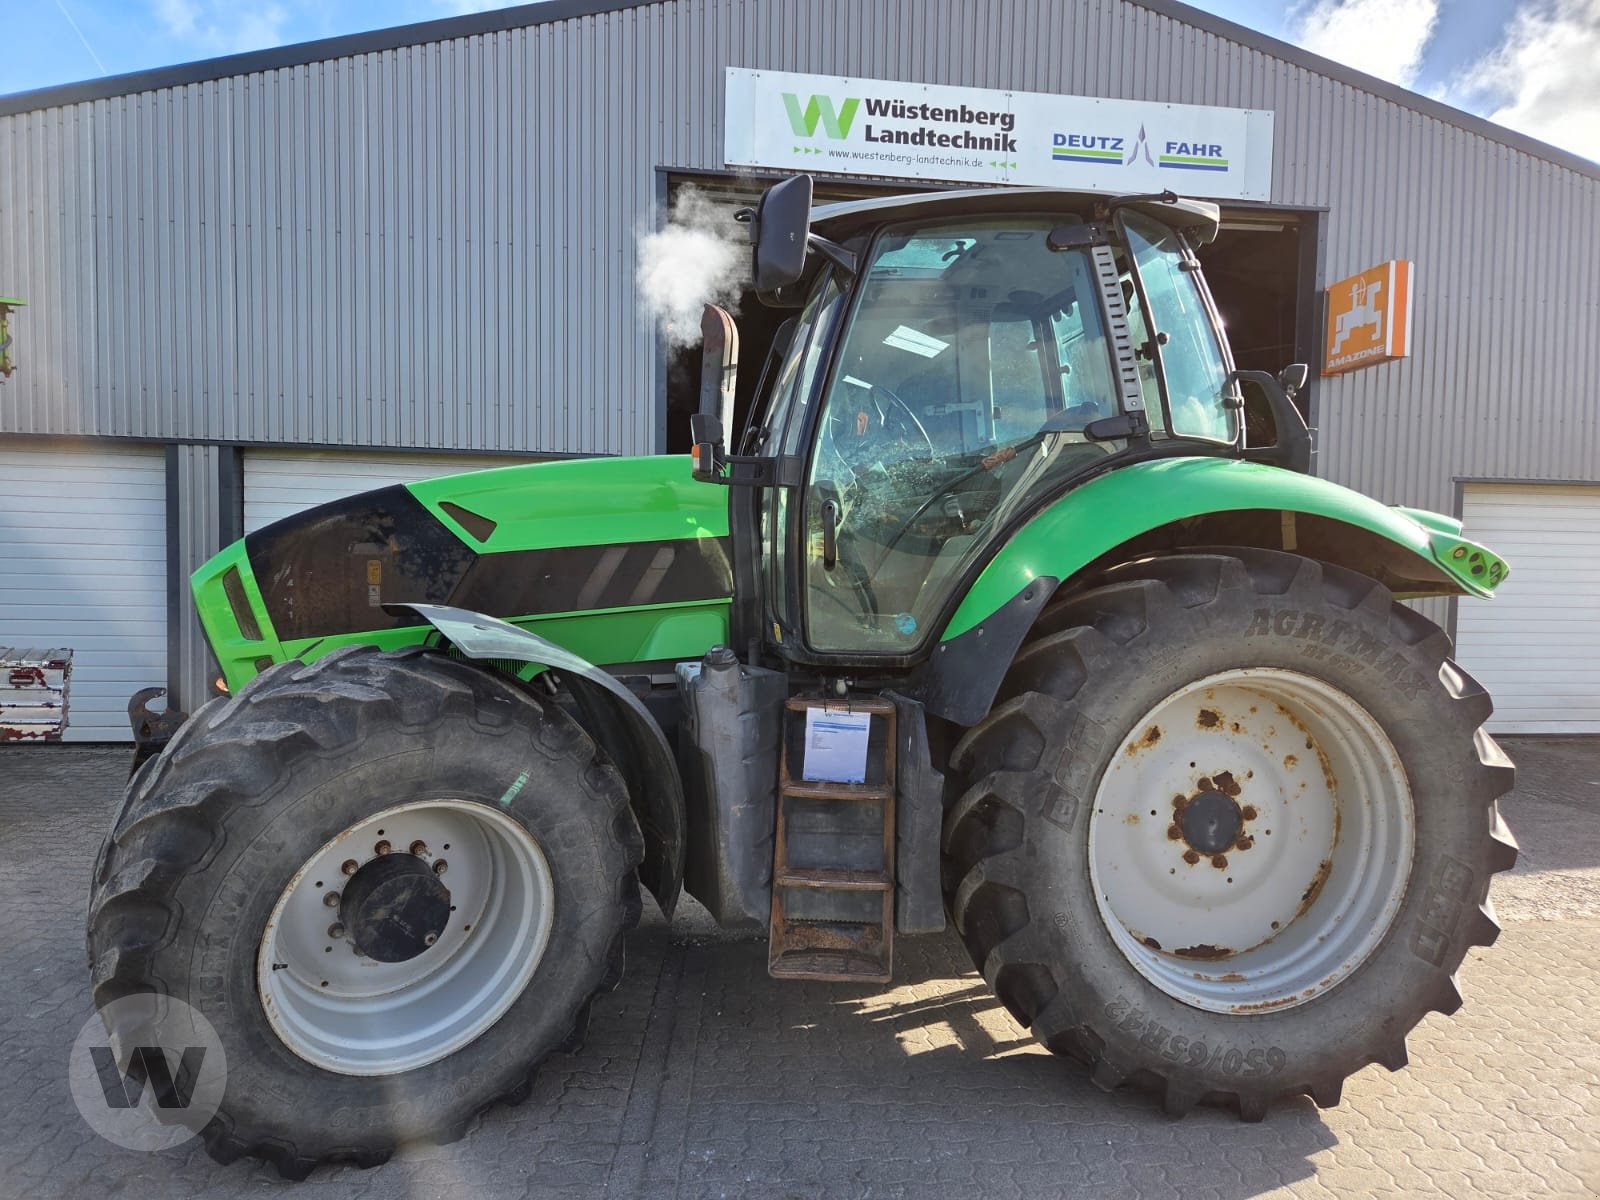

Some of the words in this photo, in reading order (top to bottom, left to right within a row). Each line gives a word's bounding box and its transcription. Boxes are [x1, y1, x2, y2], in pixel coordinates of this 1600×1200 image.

[865, 98, 1016, 132] Wüstenberg
[865, 124, 1017, 153] Landtechnik
[1053, 133, 1124, 151] DEUTZ
[1166, 141, 1223, 158] FAHR
[828, 149, 983, 168] www.wuestenberg-landtechnik.de
[1328, 344, 1385, 369] AMAZONE
[1104, 994, 1287, 1076] 650/65R42
